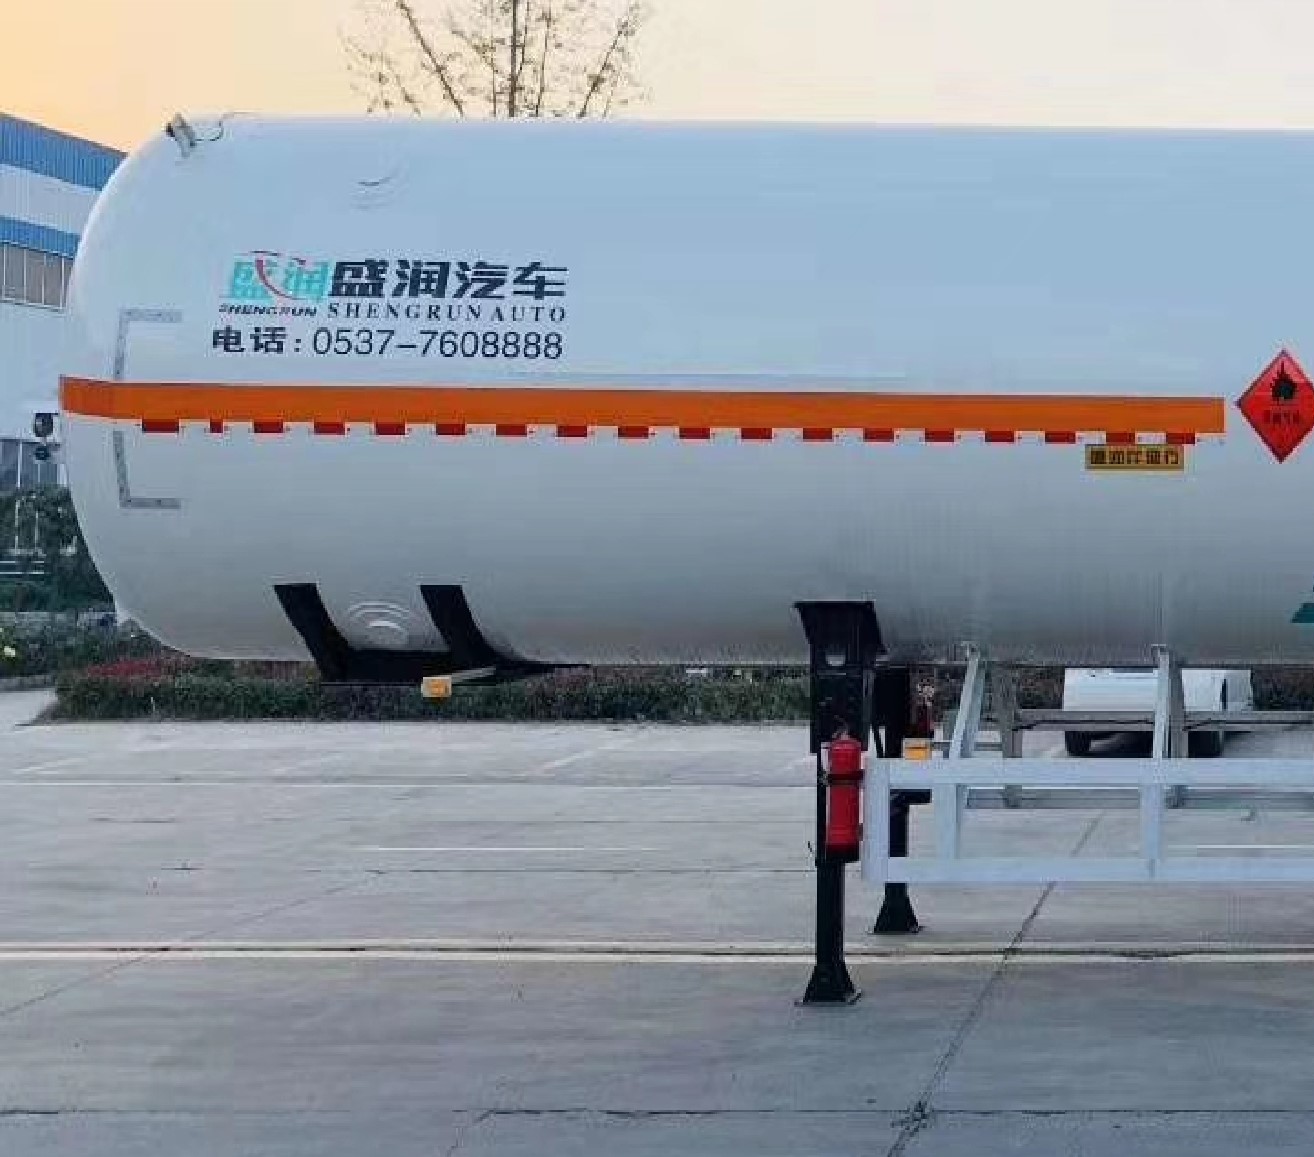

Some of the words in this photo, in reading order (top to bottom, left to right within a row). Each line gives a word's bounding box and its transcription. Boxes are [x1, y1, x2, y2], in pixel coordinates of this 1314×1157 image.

[328, 259, 570, 300] 盛润汽车
[327, 302, 482, 321] SHENGRUN
[490, 305, 566, 322] AUTO
